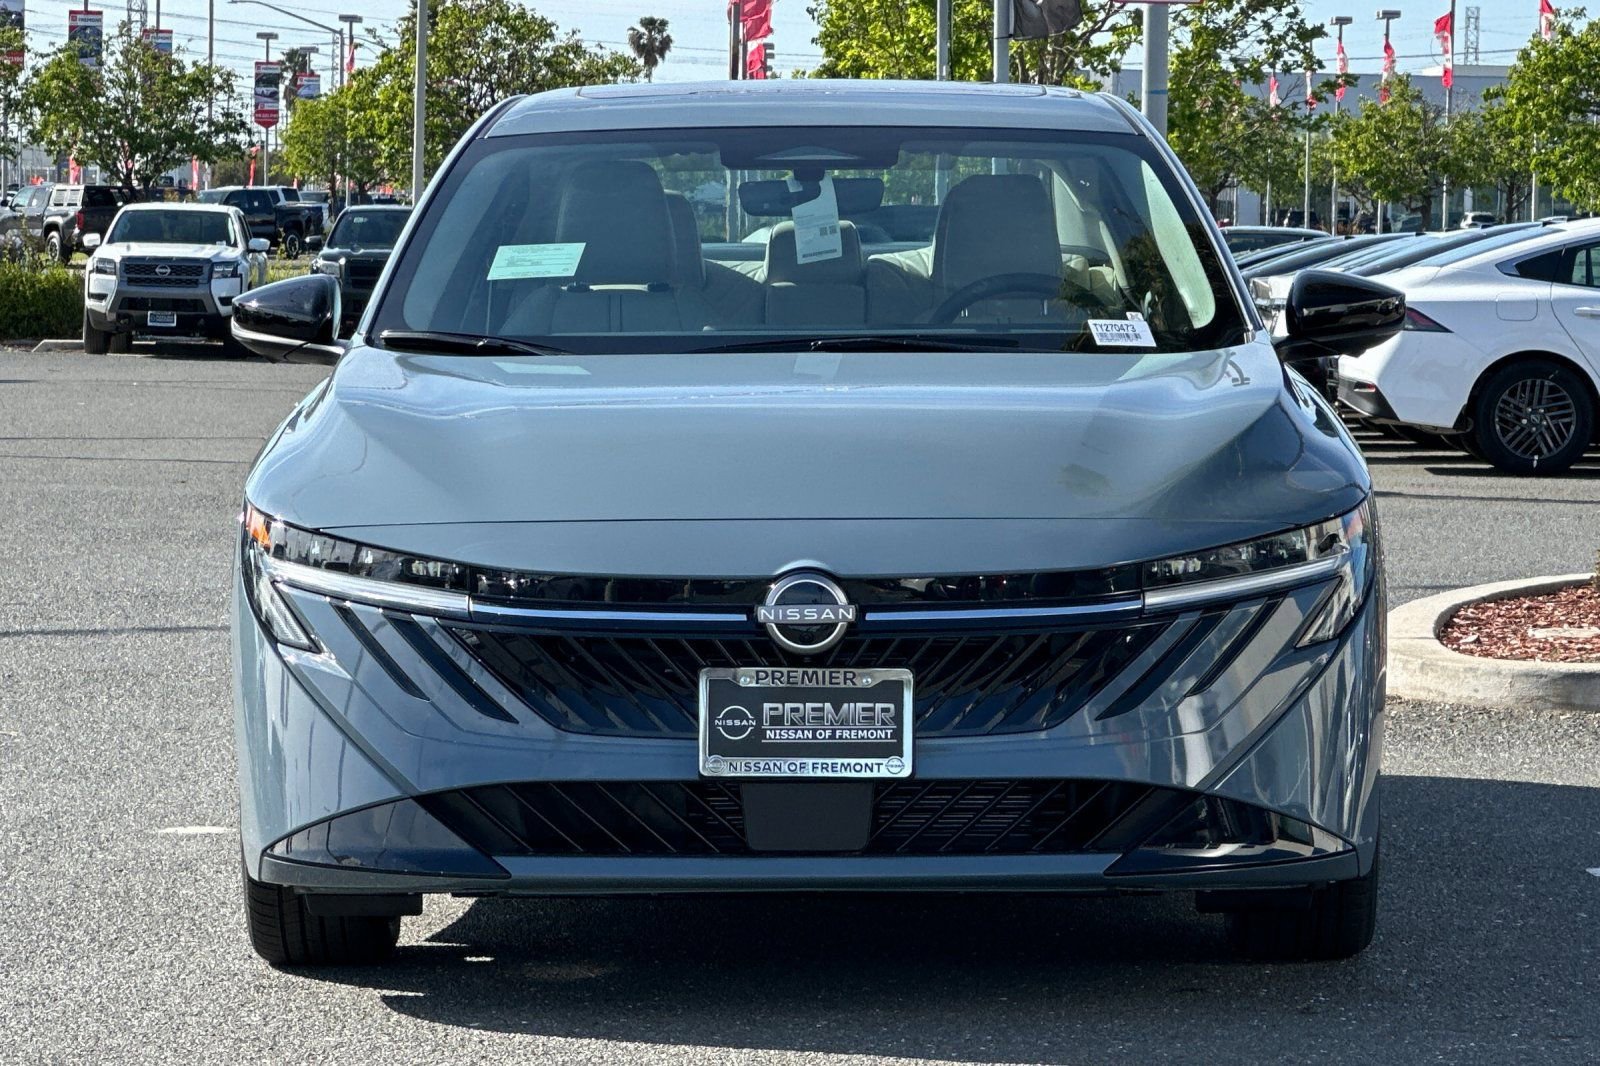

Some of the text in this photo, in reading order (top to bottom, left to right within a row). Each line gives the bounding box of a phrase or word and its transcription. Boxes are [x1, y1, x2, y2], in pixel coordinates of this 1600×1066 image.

[1092, 323, 1137, 333] TY270473
[760, 608, 853, 620] NISSAN
[755, 670, 858, 686] PREMIER
[763, 702, 896, 726] PREMIER
[766, 729, 893, 739] NISSAN OF FREMONT
[728, 761, 784, 773] NISSAN
[787, 761, 807, 773] OF
[811, 761, 884, 773] FREMONT
